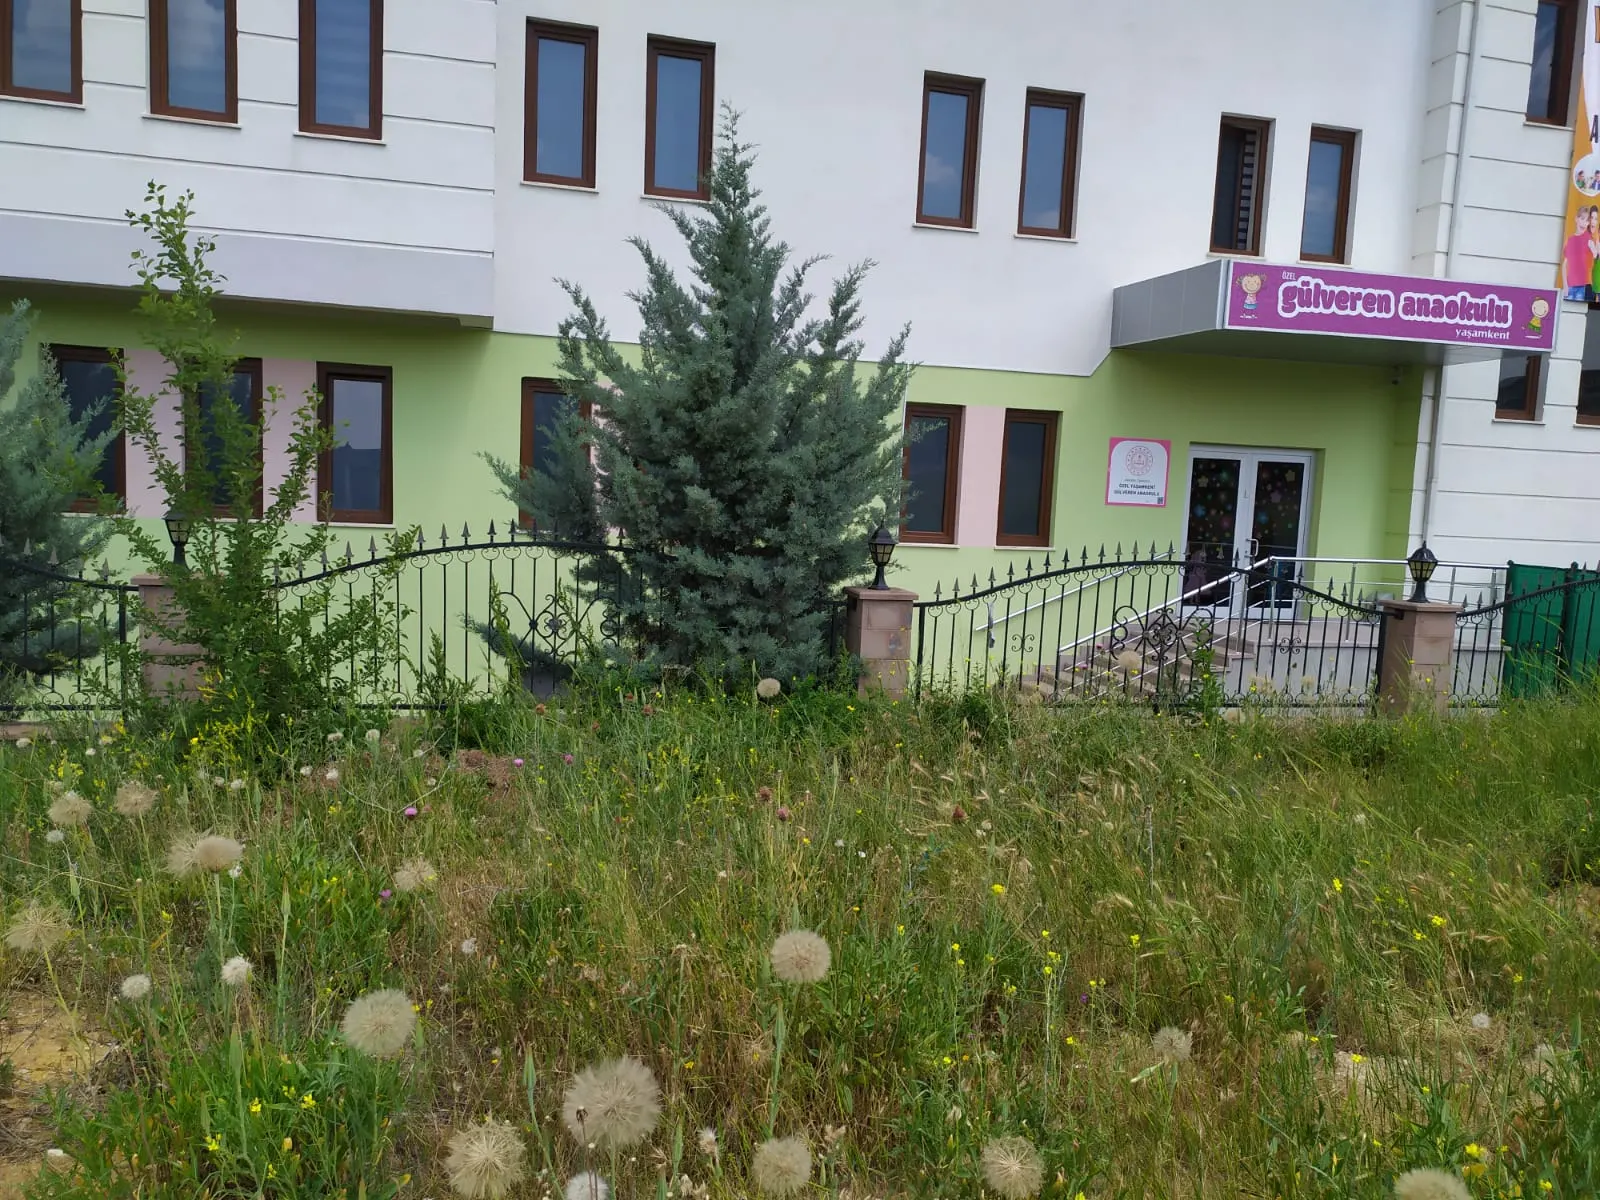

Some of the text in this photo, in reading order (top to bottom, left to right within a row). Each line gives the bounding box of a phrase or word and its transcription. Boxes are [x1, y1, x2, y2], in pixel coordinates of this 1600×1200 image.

[1281, 270, 1297, 280] ÖZEL
[1279, 278, 1511, 326] gülveren anaokulu
[1456, 328, 1510, 340] yaşamkent
